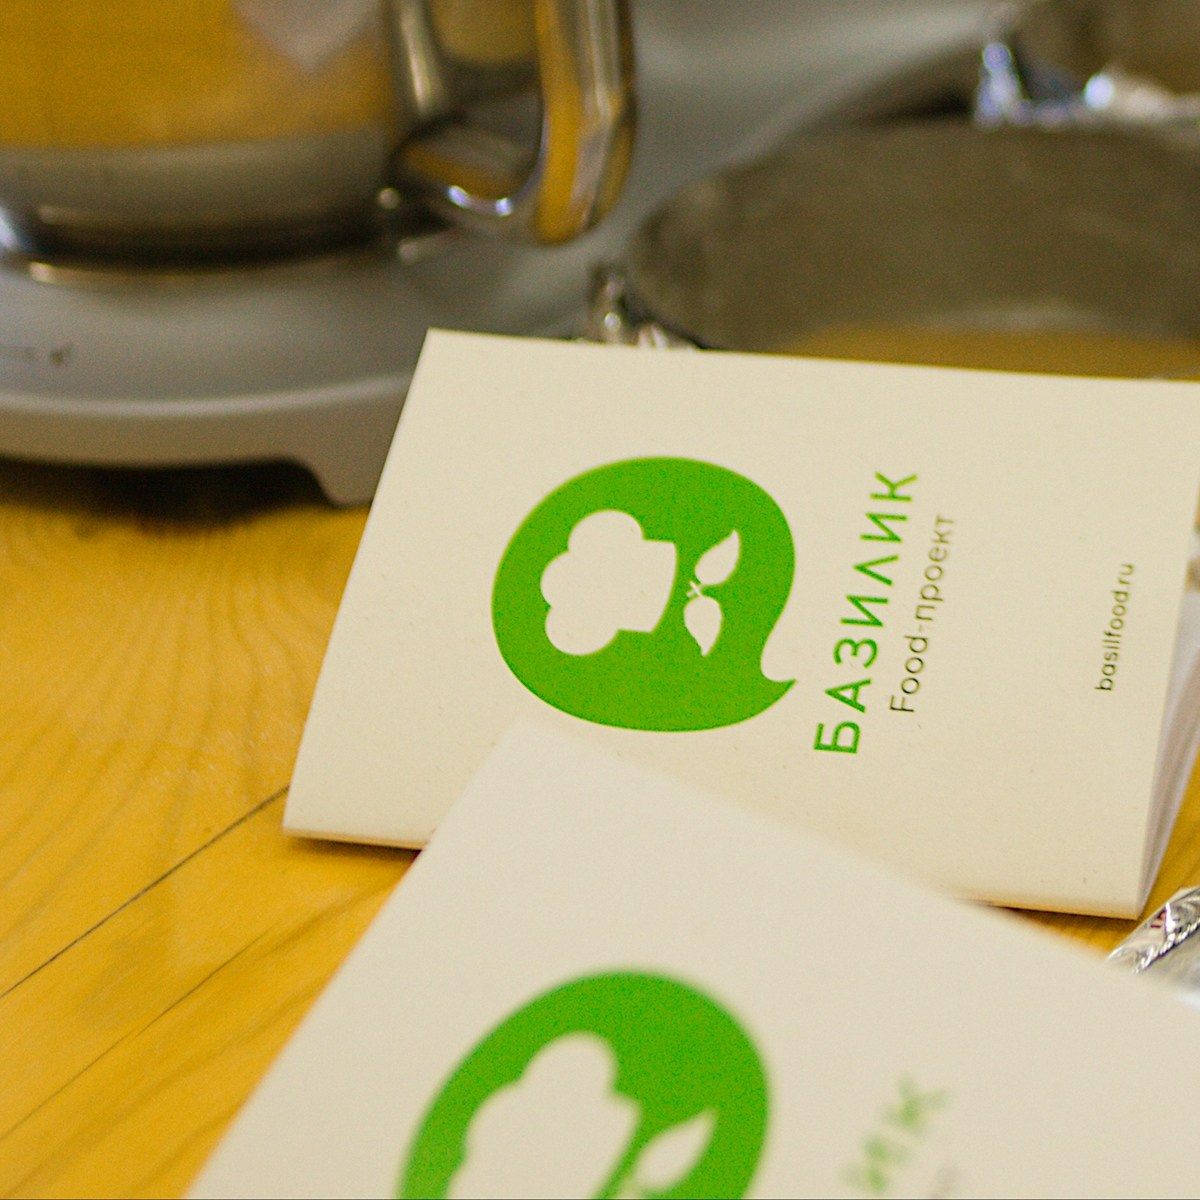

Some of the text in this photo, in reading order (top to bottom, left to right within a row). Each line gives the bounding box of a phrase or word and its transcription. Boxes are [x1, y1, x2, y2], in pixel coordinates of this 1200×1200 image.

[813, 471, 918, 754] БАЗИЛИК
[889, 513, 955, 713] Food-проект
[1095, 563, 1135, 692] basilfood.ru
